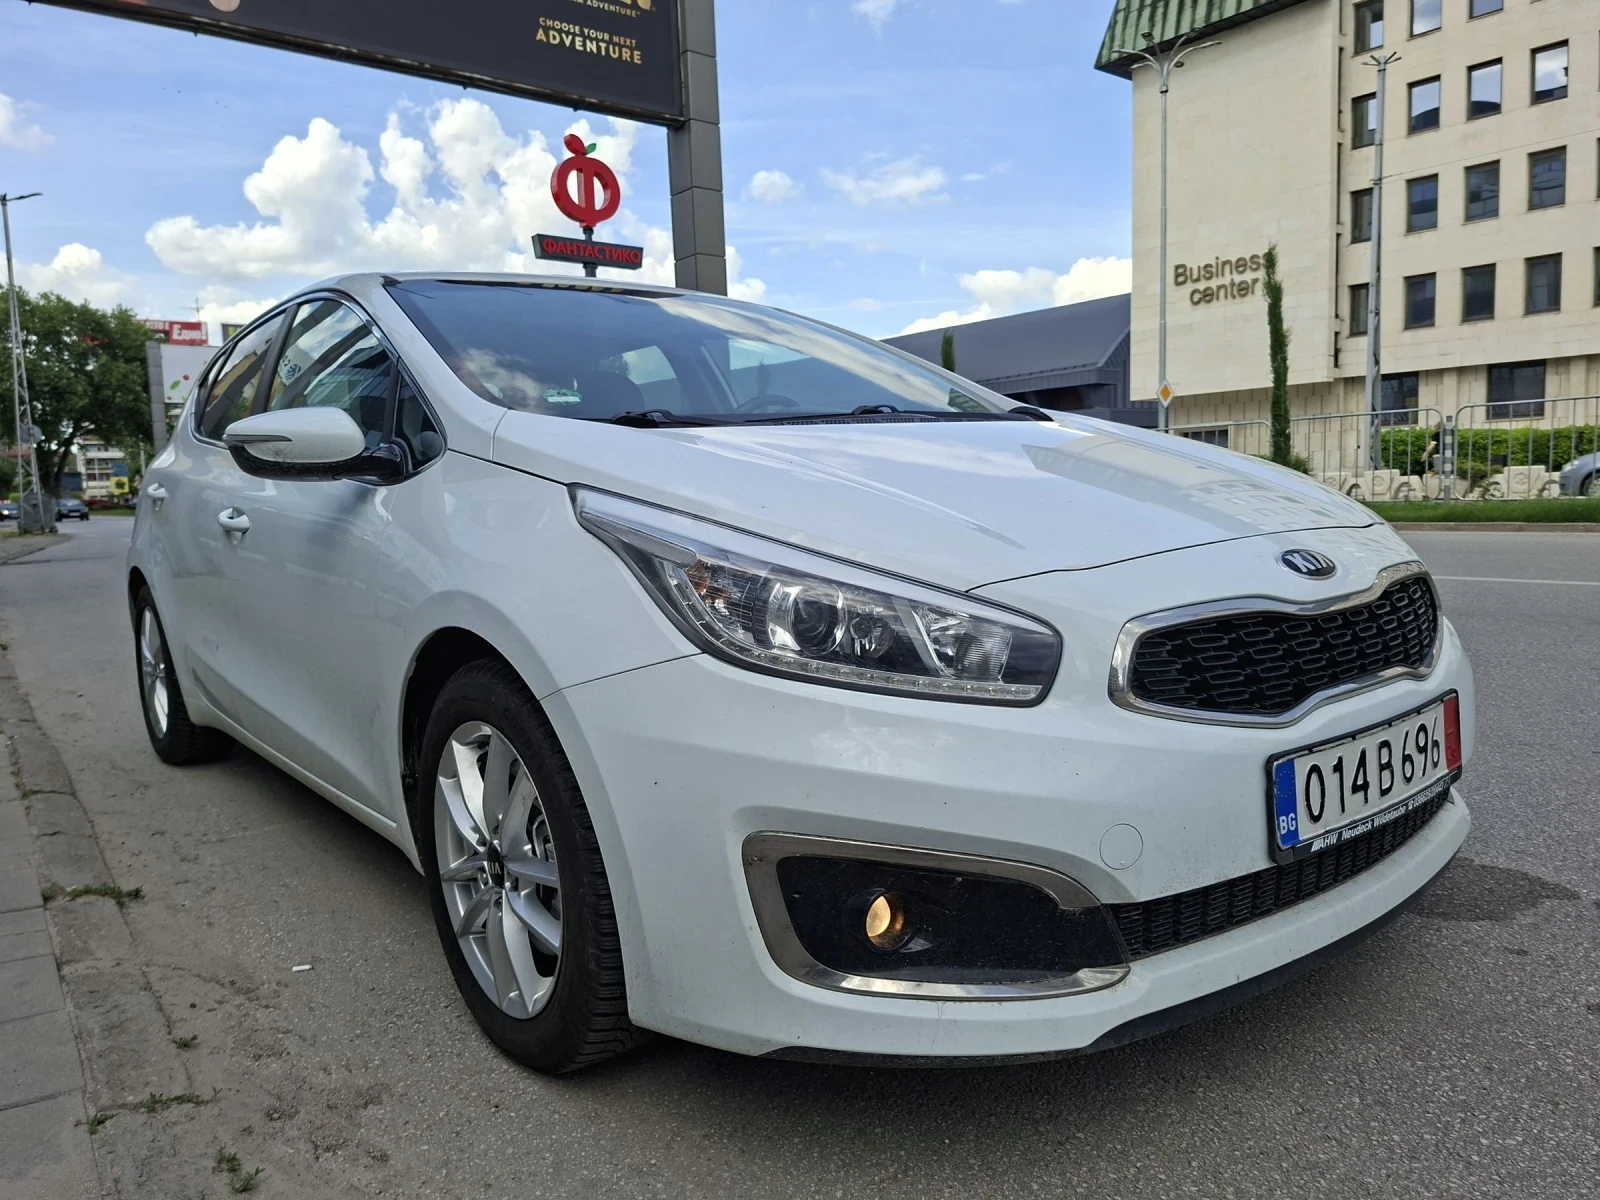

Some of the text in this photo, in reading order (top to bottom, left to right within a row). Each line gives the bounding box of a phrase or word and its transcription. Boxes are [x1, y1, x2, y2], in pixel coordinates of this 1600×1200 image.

[535, 27, 642, 64] ADVENTURE
[539, 17, 637, 48] CHOOSE YOUR NEXT
[543, 238, 641, 263] ФАНТАСТИКО
[1190, 278, 1259, 305] center
[1279, 813, 1297, 834] BG
[1341, 820, 1373, 841] Neudeck
